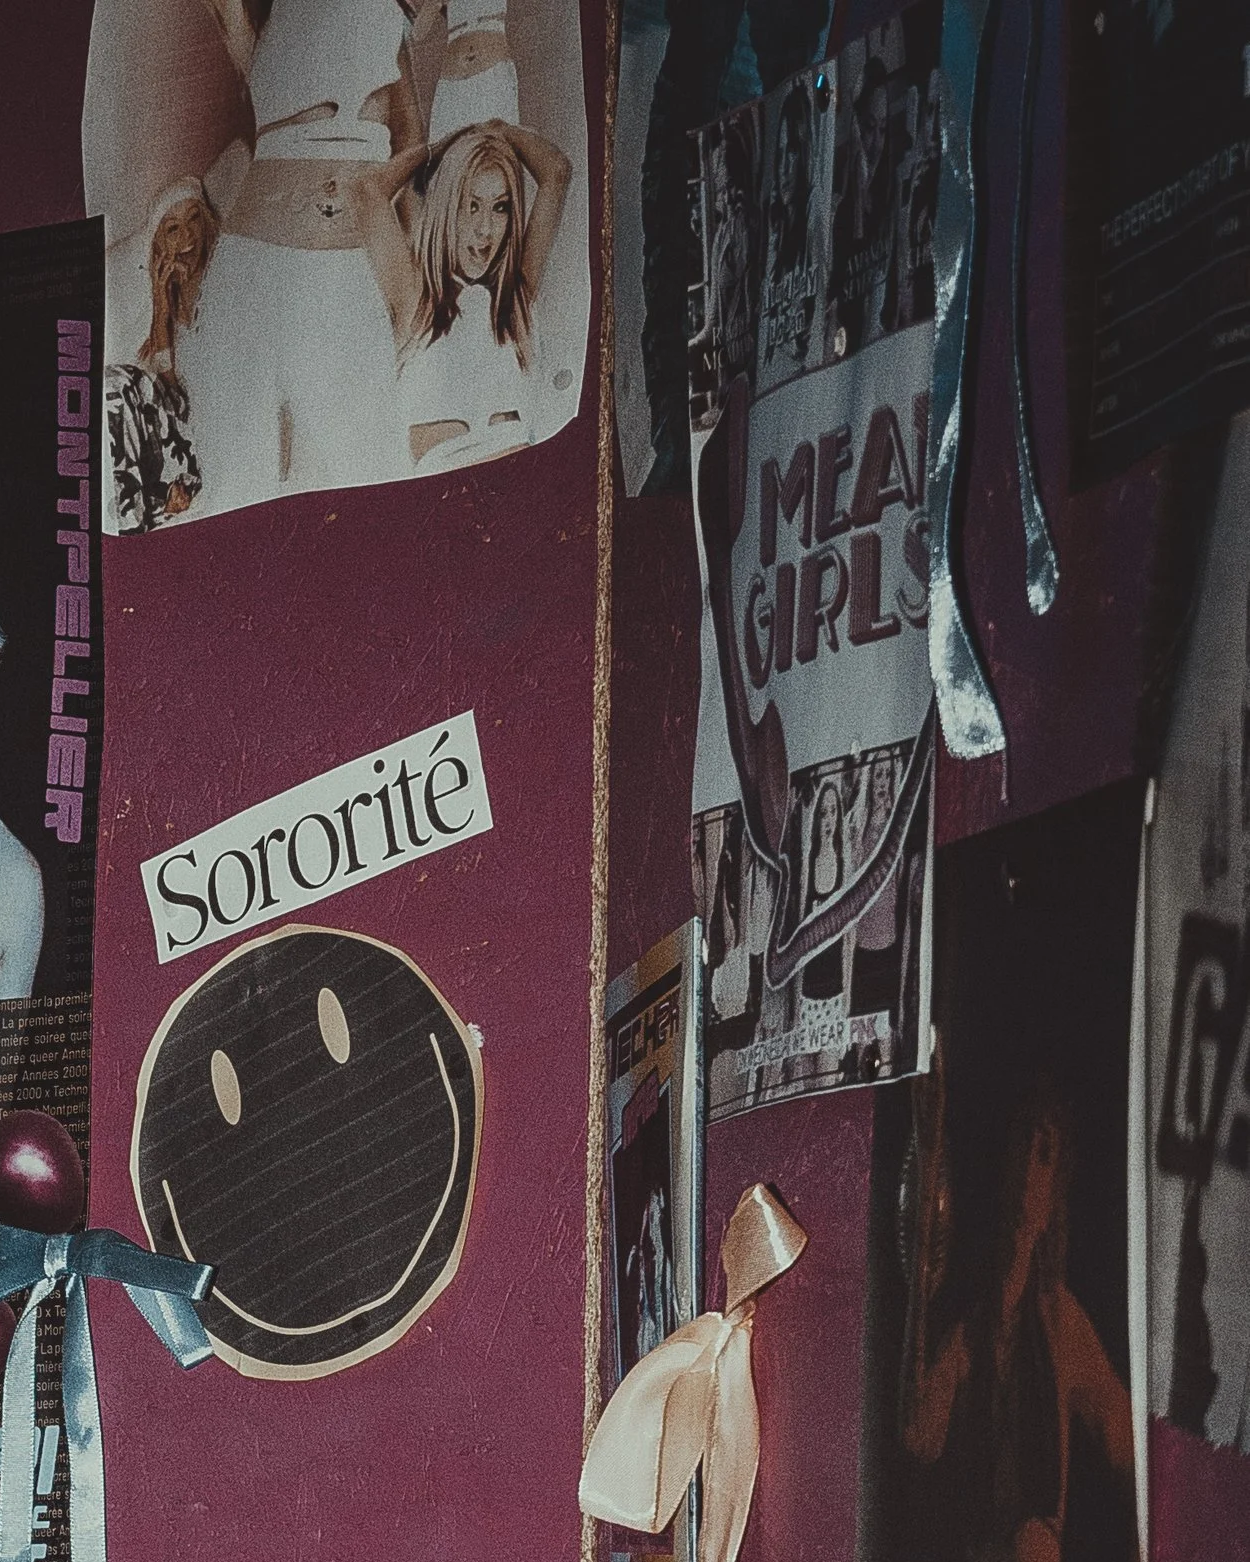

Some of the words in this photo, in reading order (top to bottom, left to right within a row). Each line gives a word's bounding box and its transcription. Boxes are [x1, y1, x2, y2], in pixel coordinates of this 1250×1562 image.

[45, 319, 91, 844] MONTPELLIER
[157, 730, 475, 952] Sororité
[17, 1011, 64, 1030] première
[34, 1030, 66, 1045] soirée
[30, 1050, 57, 1065] queer
[22, 1067, 58, 1083] Années
[62, 1065, 89, 1079] 2000
[16, 1086, 41, 1101] 2000
[53, 1083, 88, 1099] Techno
